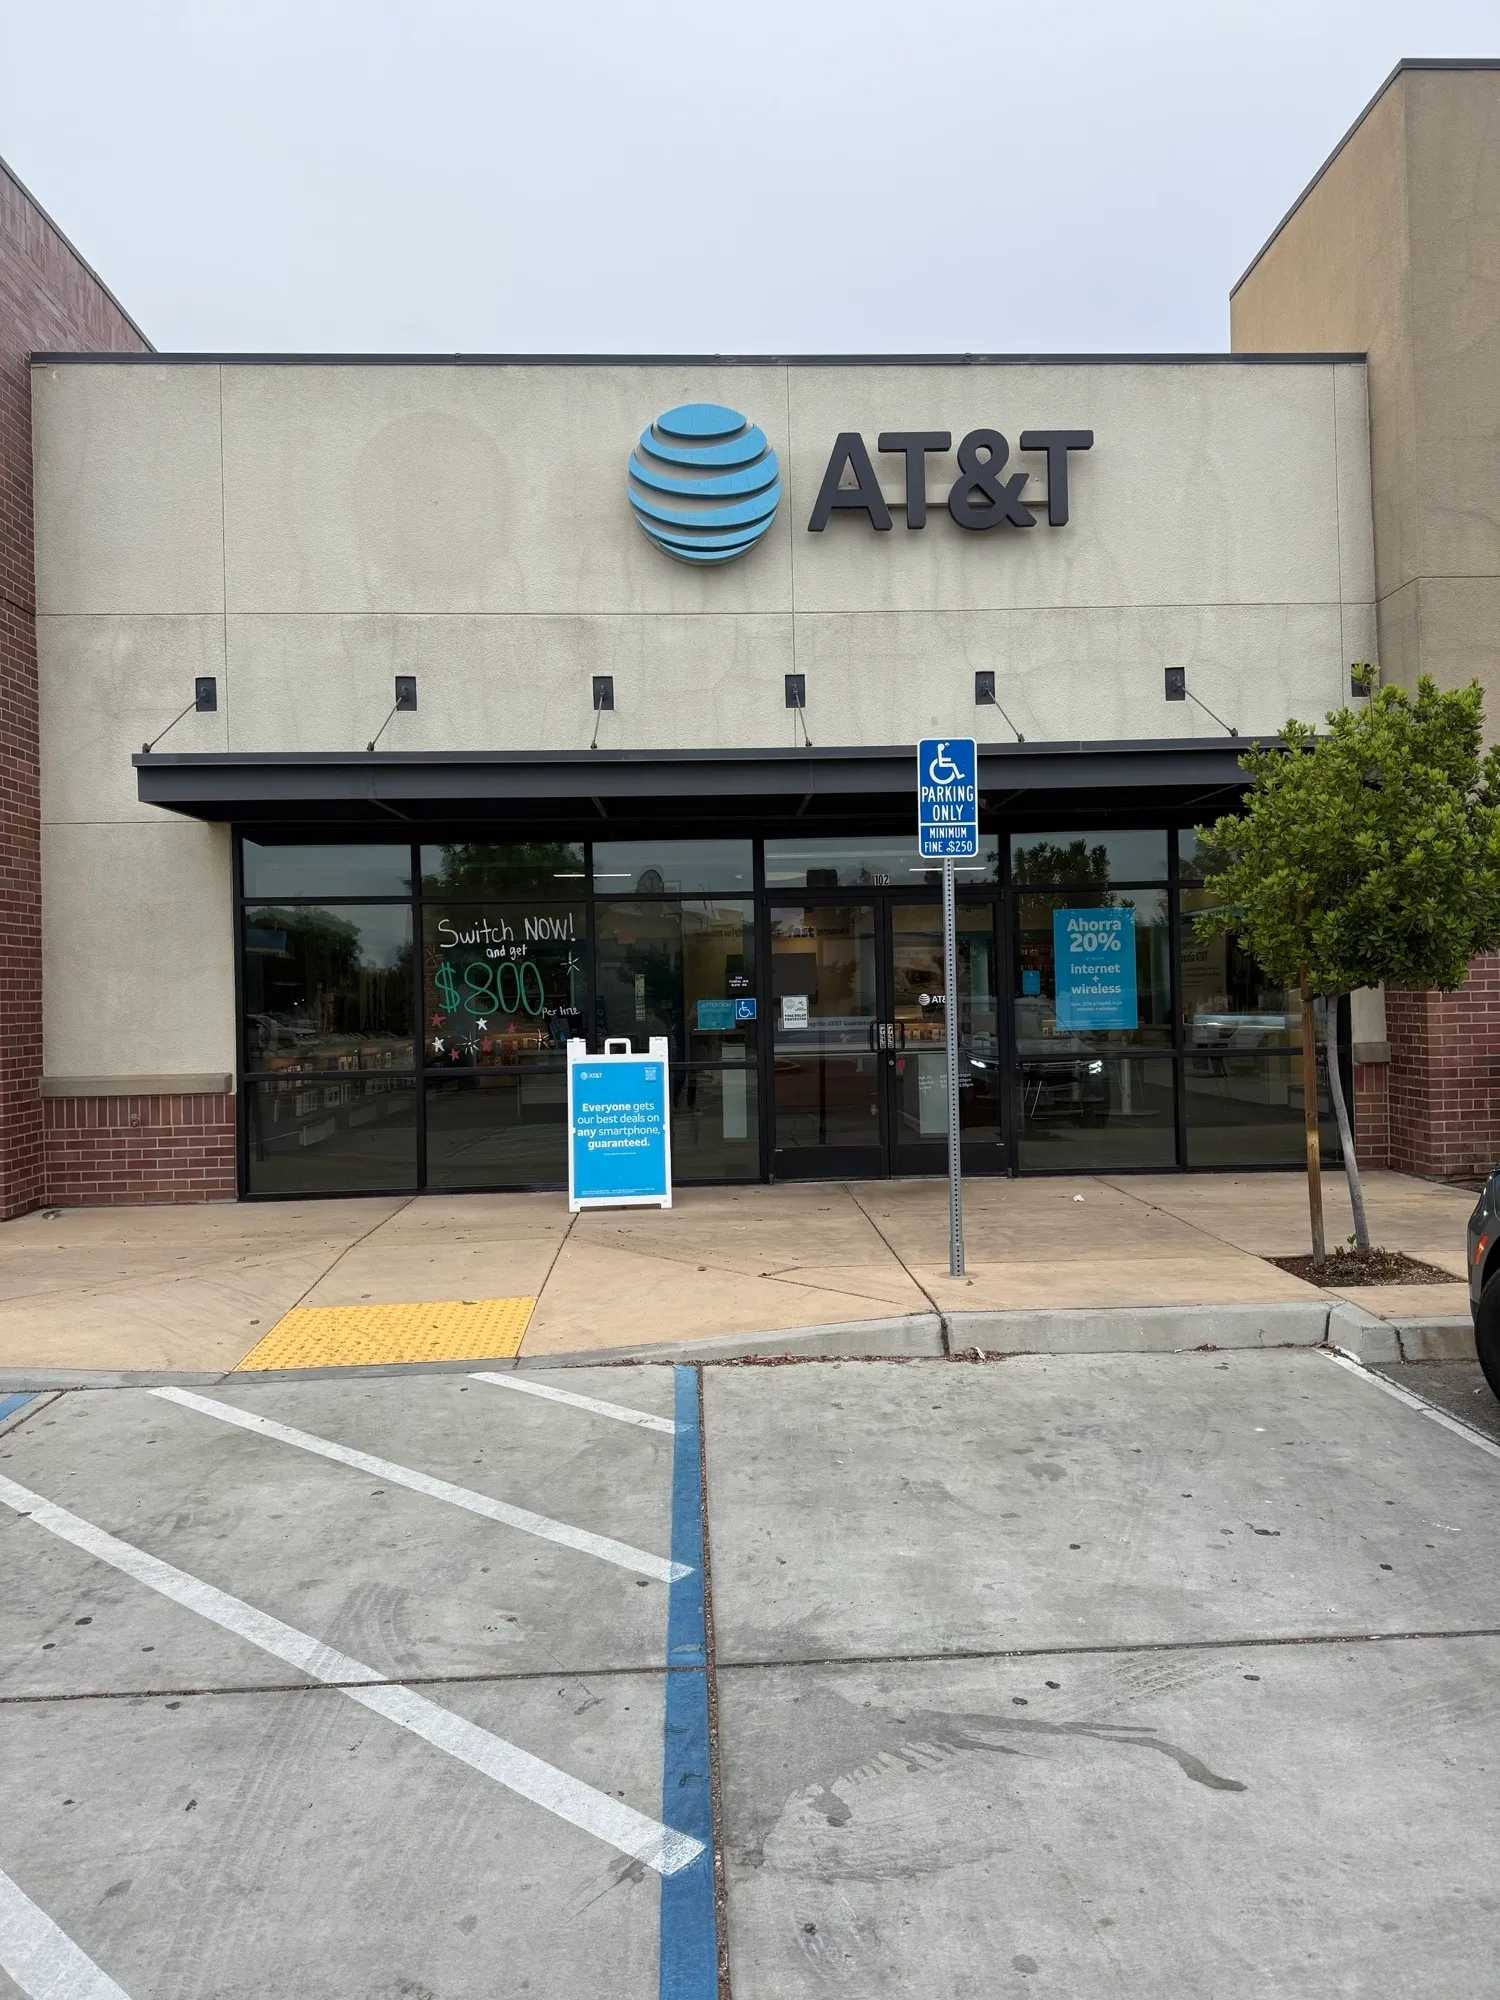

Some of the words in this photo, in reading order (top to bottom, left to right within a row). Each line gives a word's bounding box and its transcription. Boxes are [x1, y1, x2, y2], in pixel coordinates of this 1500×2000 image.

[807, 428, 1094, 532] AT&T
[921, 785, 974, 803] PARKING
[932, 804, 964, 821] ONLY
[929, 827, 967, 839] MINIMUM
[924, 841, 943, 853] FINE
[948, 840, 973, 853] $250
[874, 873, 890, 886] 102
[437, 918, 514, 948] Switch
[524, 912, 576, 942] NOW!
[1067, 917, 1122, 932] Ahorra
[1070, 932, 1122, 953] 20%
[486, 945, 506, 958] and
[509, 944, 528, 960] get
[1070, 963, 1121, 975] internet
[434, 961, 545, 1016] $800
[1071, 983, 1122, 995] wireless
[560, 1006, 580, 1015] line
[582, 1102, 631, 1114] Everyone
[632, 1102, 655, 1114] gets
[577, 1116, 593, 1124] our
[596, 1113, 618, 1124] best
[619, 1113, 645, 1123] deals
[647, 1114, 660, 1122] on
[577, 1128, 597, 1139] any
[598, 1125, 661, 1138] smartphone,
[587, 1138, 651, 1151] guaranteed.
